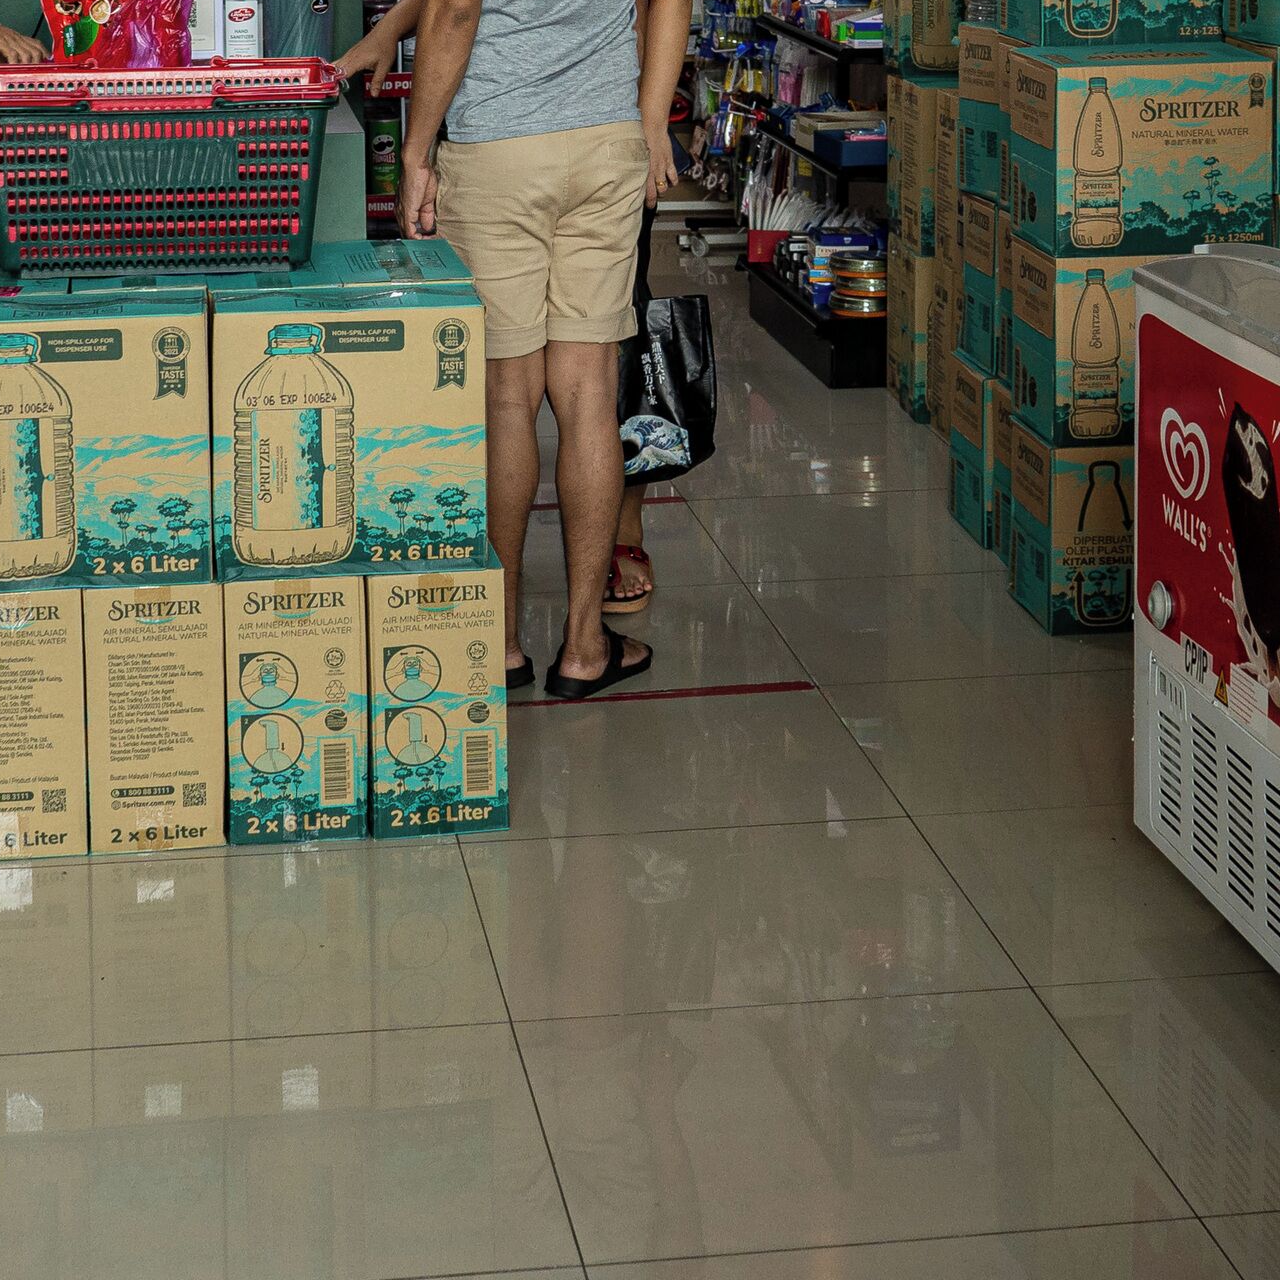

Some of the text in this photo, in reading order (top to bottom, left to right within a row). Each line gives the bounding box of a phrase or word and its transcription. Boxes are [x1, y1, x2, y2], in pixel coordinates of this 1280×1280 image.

[1140, 98, 1240, 122] SPRITZER
[1091, 111, 1103, 157] SPRITZER
[1131, 128, 1249, 139] NATURAL MINERAL WATER
[368, 202, 395, 211] MIND
[1204, 234, 1216, 243] 12
[1228, 232, 1264, 242] 1250ml
[332, 329, 367, 337] NON-SPILL
[48, 336, 114, 346] NON-SPILL CAP FOR
[440, 361, 464, 370] TASTE
[160, 370, 185, 379] TASTE
[246, 393, 337, 407] 03 06 EXP 100624
[20, 402, 55, 414] 100624
[257, 437, 272, 504] SPRITZER
[1162, 494, 1207, 552] WALL'S
[370, 544, 474, 562] 2 x 6 Liter
[93, 556, 199, 574] 2 x 6 Liter
[243, 591, 345, 615] SPRITZER
[387, 584, 488, 608] SPRITZER
[108, 600, 201, 621] SPRITZER
[382, 610, 495, 625] AIR MINERAL SEMULAJADI
[255, 620, 295, 629] MINERAL
[297, 617, 352, 627] SEMULAJADI
[382, 620, 495, 634] NATURAL MINERAL WATER
[238, 626, 352, 640] NATURAL MINERAL WATER
[391, 805, 492, 827] 2 x 6 Liter
[111, 825, 208, 843] 2 x 6 Liter
